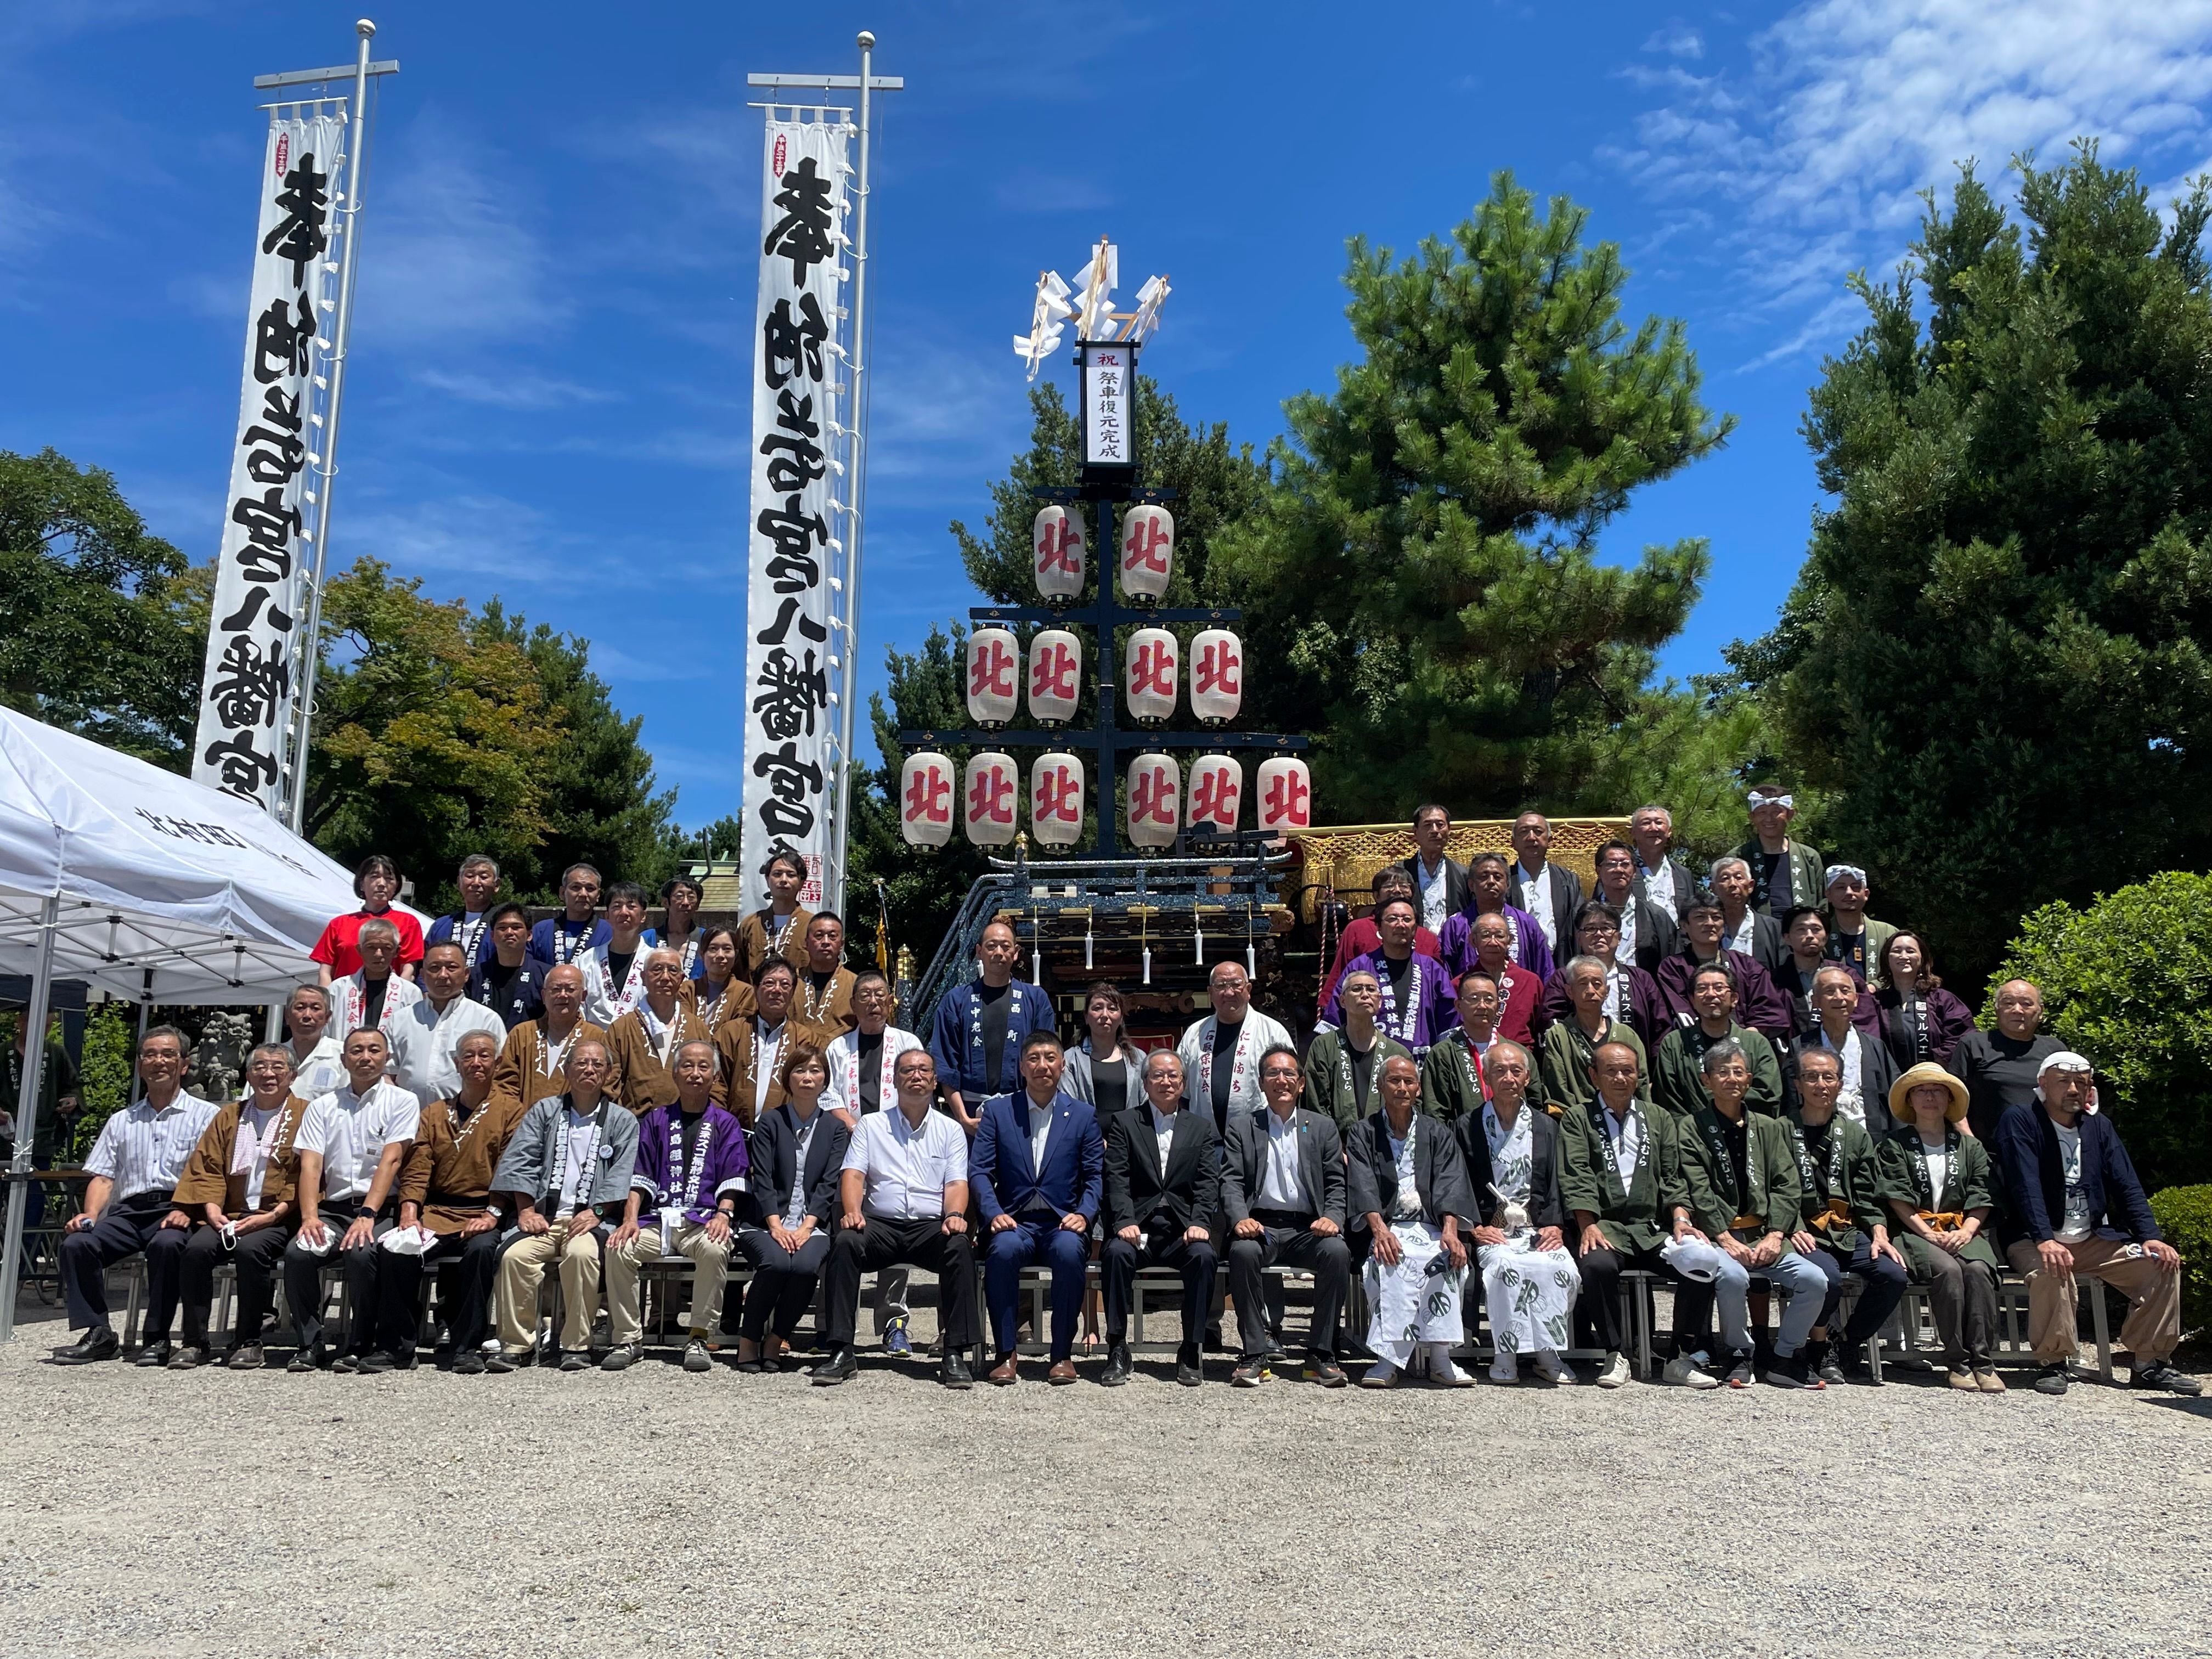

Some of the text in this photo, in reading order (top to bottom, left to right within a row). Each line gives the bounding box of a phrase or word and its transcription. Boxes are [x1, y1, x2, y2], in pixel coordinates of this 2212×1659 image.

[1097, 353, 1120, 459] 祝 祭車復元完成
[1039, 517, 1081, 573] 北
[1125, 516, 1169, 572] 北
[971, 640, 1013, 696] 北
[1032, 642, 1077, 698] 北
[1131, 640, 1175, 696] 北
[1196, 640, 1239, 695] 北
[906, 766, 950, 822] 北
[969, 765, 1013, 822] 北
[1036, 765, 1079, 822] 北
[1132, 767, 1175, 825] 北
[1192, 768, 1237, 825] 北
[1266, 770, 1307, 825] 北
[1867, 951, 1877, 977] 青年
[970, 1007, 983, 1047] 中老会
[1007, 1003, 1020, 1042] 西町
[1620, 984, 1632, 1023] マルスエ
[1917, 1013, 1929, 1053] マルスエ
[1200, 1030, 1216, 1093] 石取保存会
[1340, 1050, 1352, 1091] きたむら
[1463, 1052, 1480, 1093] きたむら
[1598, 1127, 1616, 1172] きたむら
[1639, 1122, 1650, 1167] きたむら
[1714, 1139, 1734, 1186] きたむら
[1798, 1142, 1813, 1189] きたむら
[1830, 1141, 1841, 1187] きたむら
[1948, 1144, 1959, 1187] きたむら
[1914, 1149, 1929, 1194] きたむら
